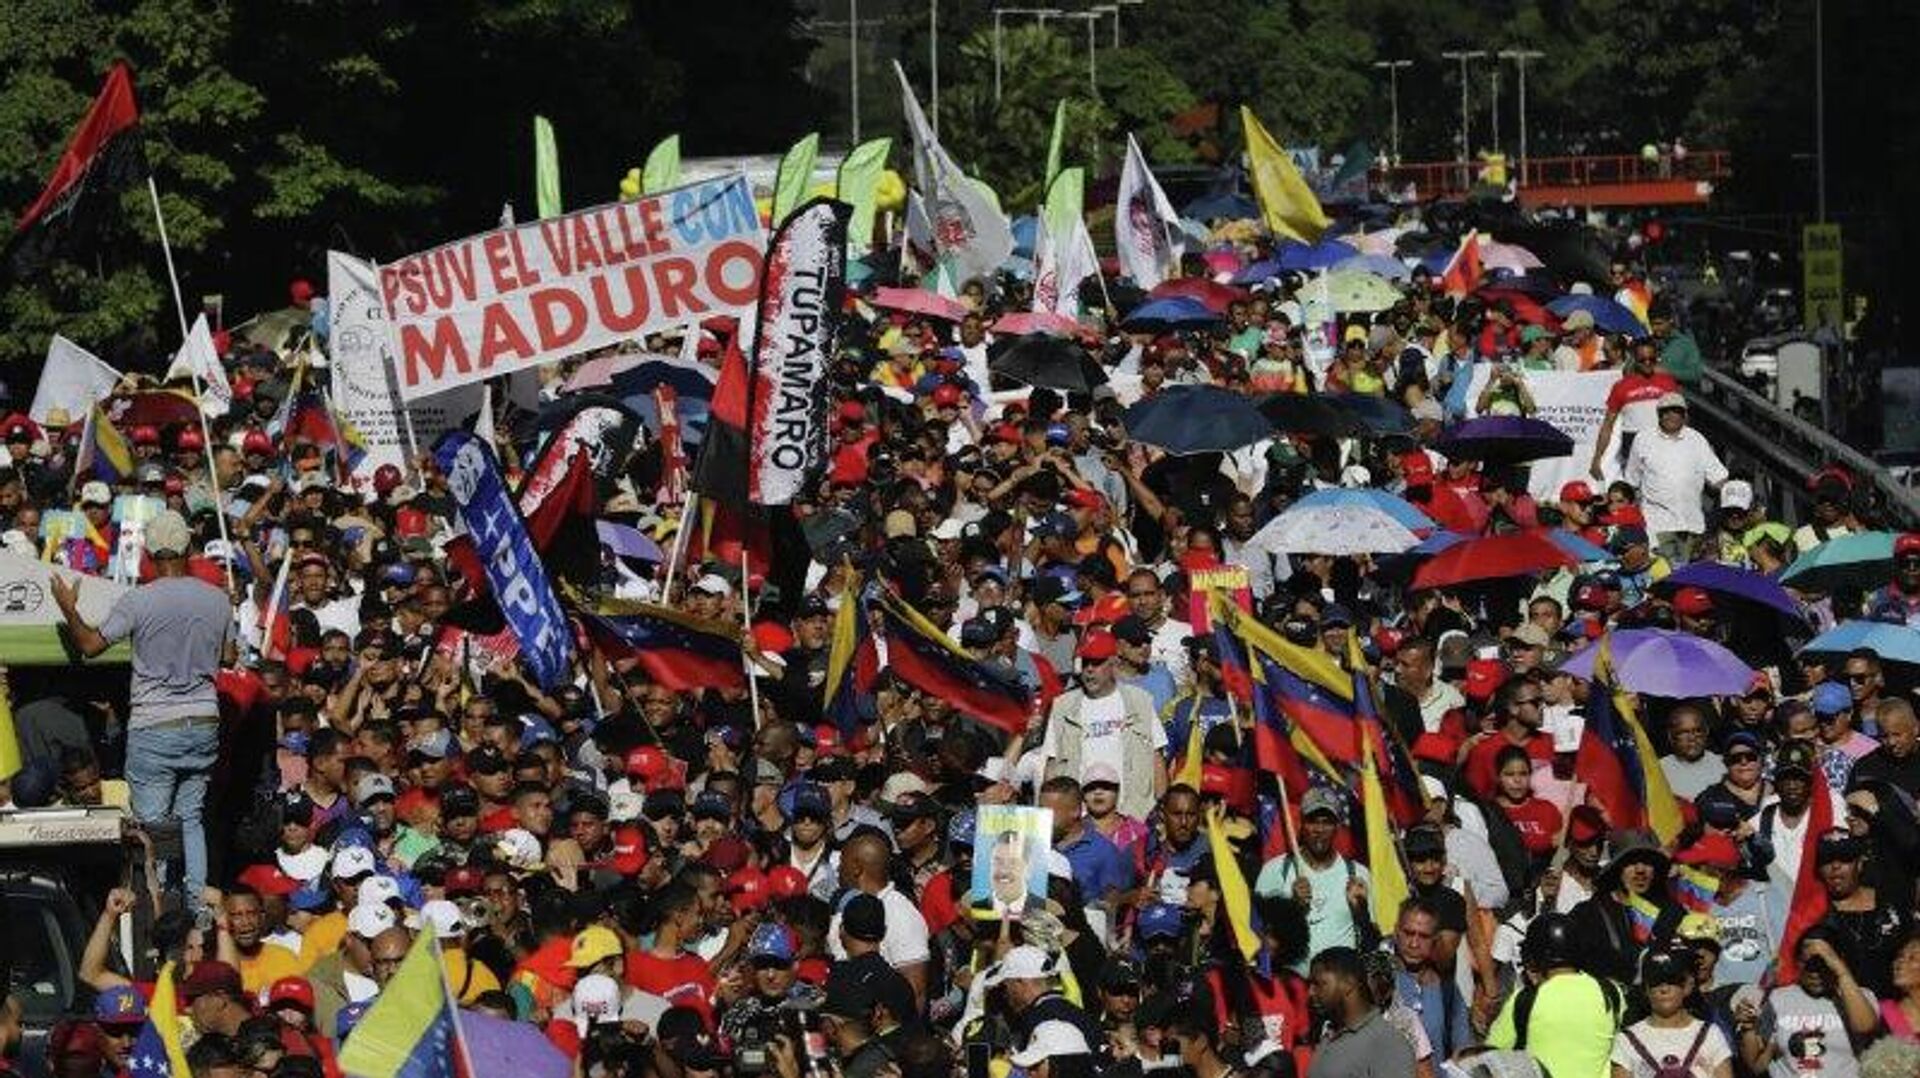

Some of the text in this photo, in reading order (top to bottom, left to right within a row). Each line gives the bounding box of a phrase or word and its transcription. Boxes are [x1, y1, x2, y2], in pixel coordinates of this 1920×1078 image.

[380, 243, 477, 321] PSUV
[484, 227, 541, 294] EL
[541, 199, 672, 278] VALLE
[672, 175, 758, 242] CON
[400, 240, 764, 386] MADURO
[771, 266, 826, 471] TUPAMARO
